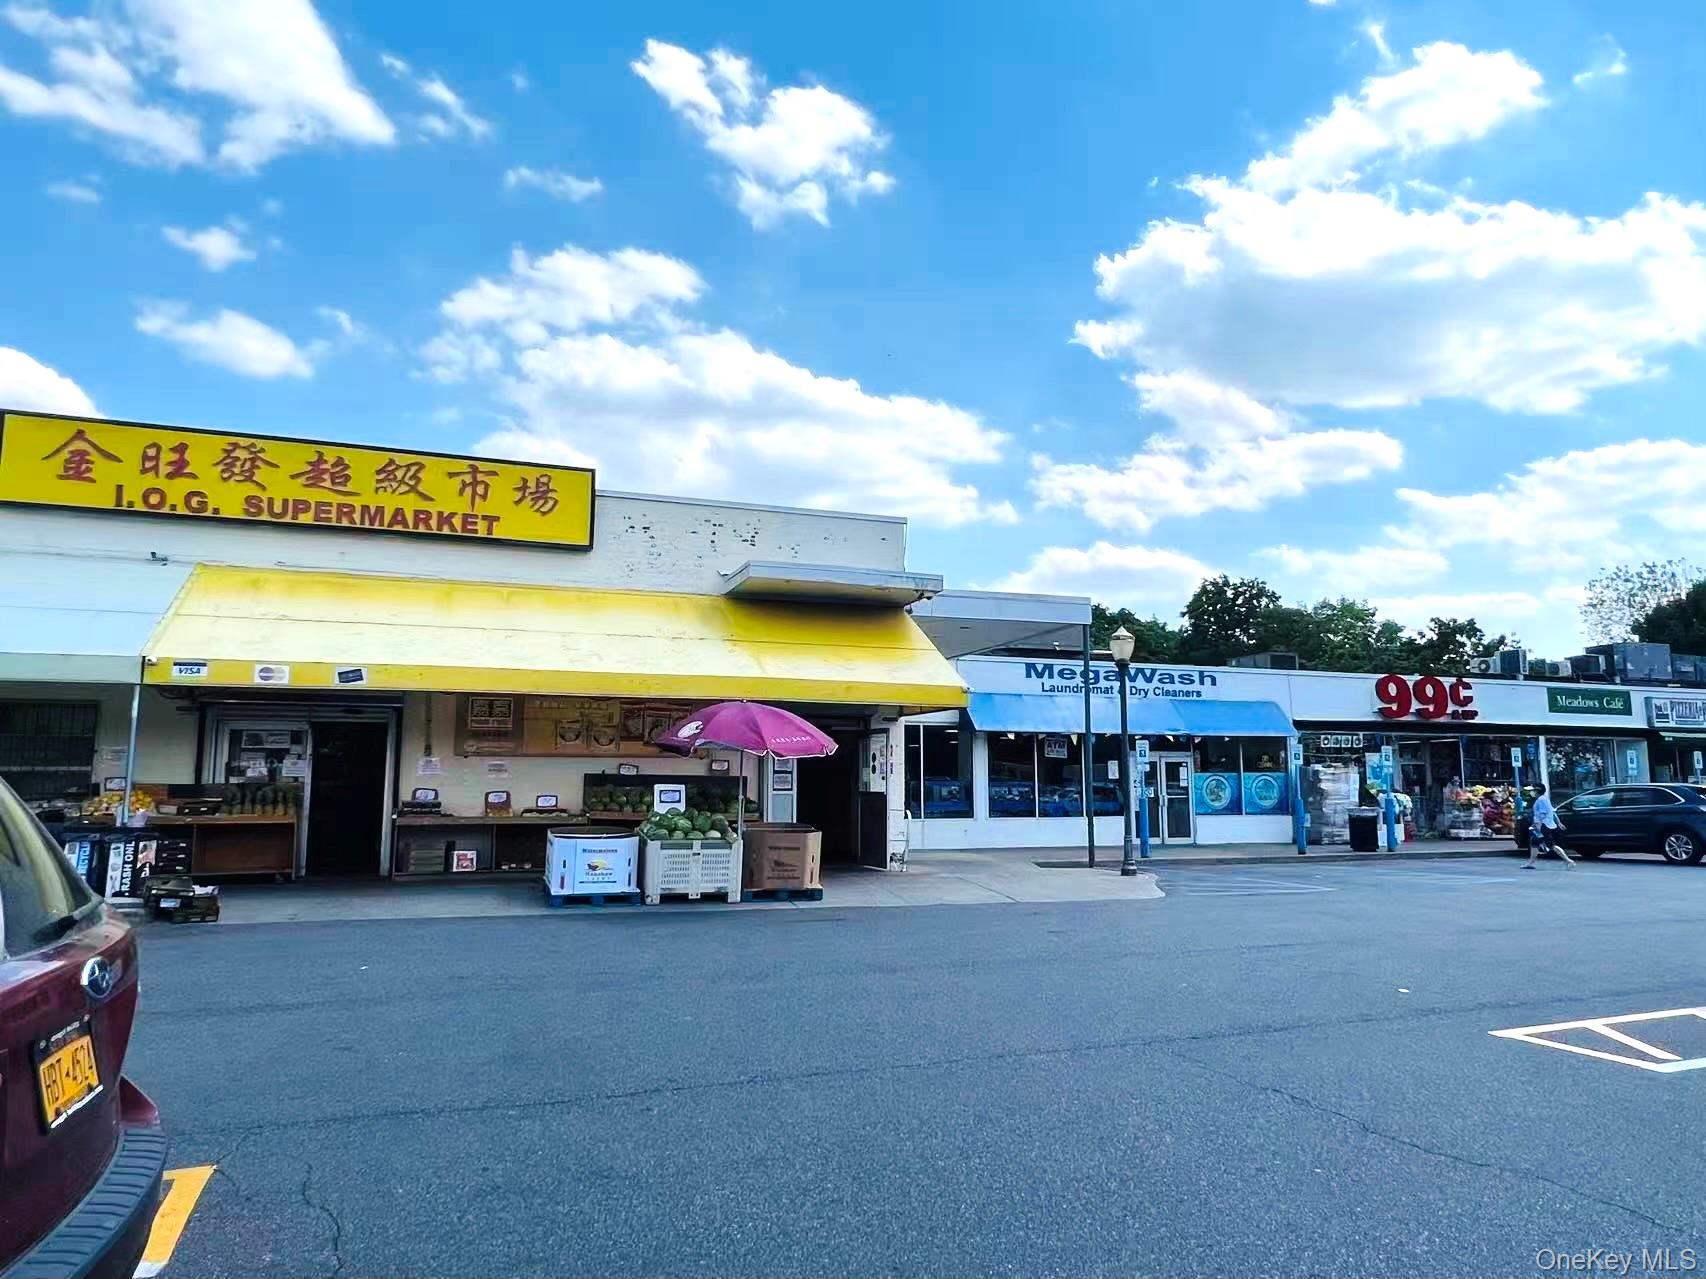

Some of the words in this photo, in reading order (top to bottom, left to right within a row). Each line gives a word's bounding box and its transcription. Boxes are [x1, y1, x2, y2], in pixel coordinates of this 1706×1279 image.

[41, 428, 560, 517] 金旺發超級市場
[114, 484, 221, 515] I.O.G.
[243, 494, 501, 536] SUPERMARKET
[178, 667, 201, 675] VISA
[1024, 663, 1217, 686] MegaWash
[1130, 685, 1149, 698] Dry
[1153, 687, 1202, 698] Cleaners
[1556, 695, 1599, 708] Meadows
[1603, 697, 1624, 709] Café
[120, 863, 133, 896] RASH
